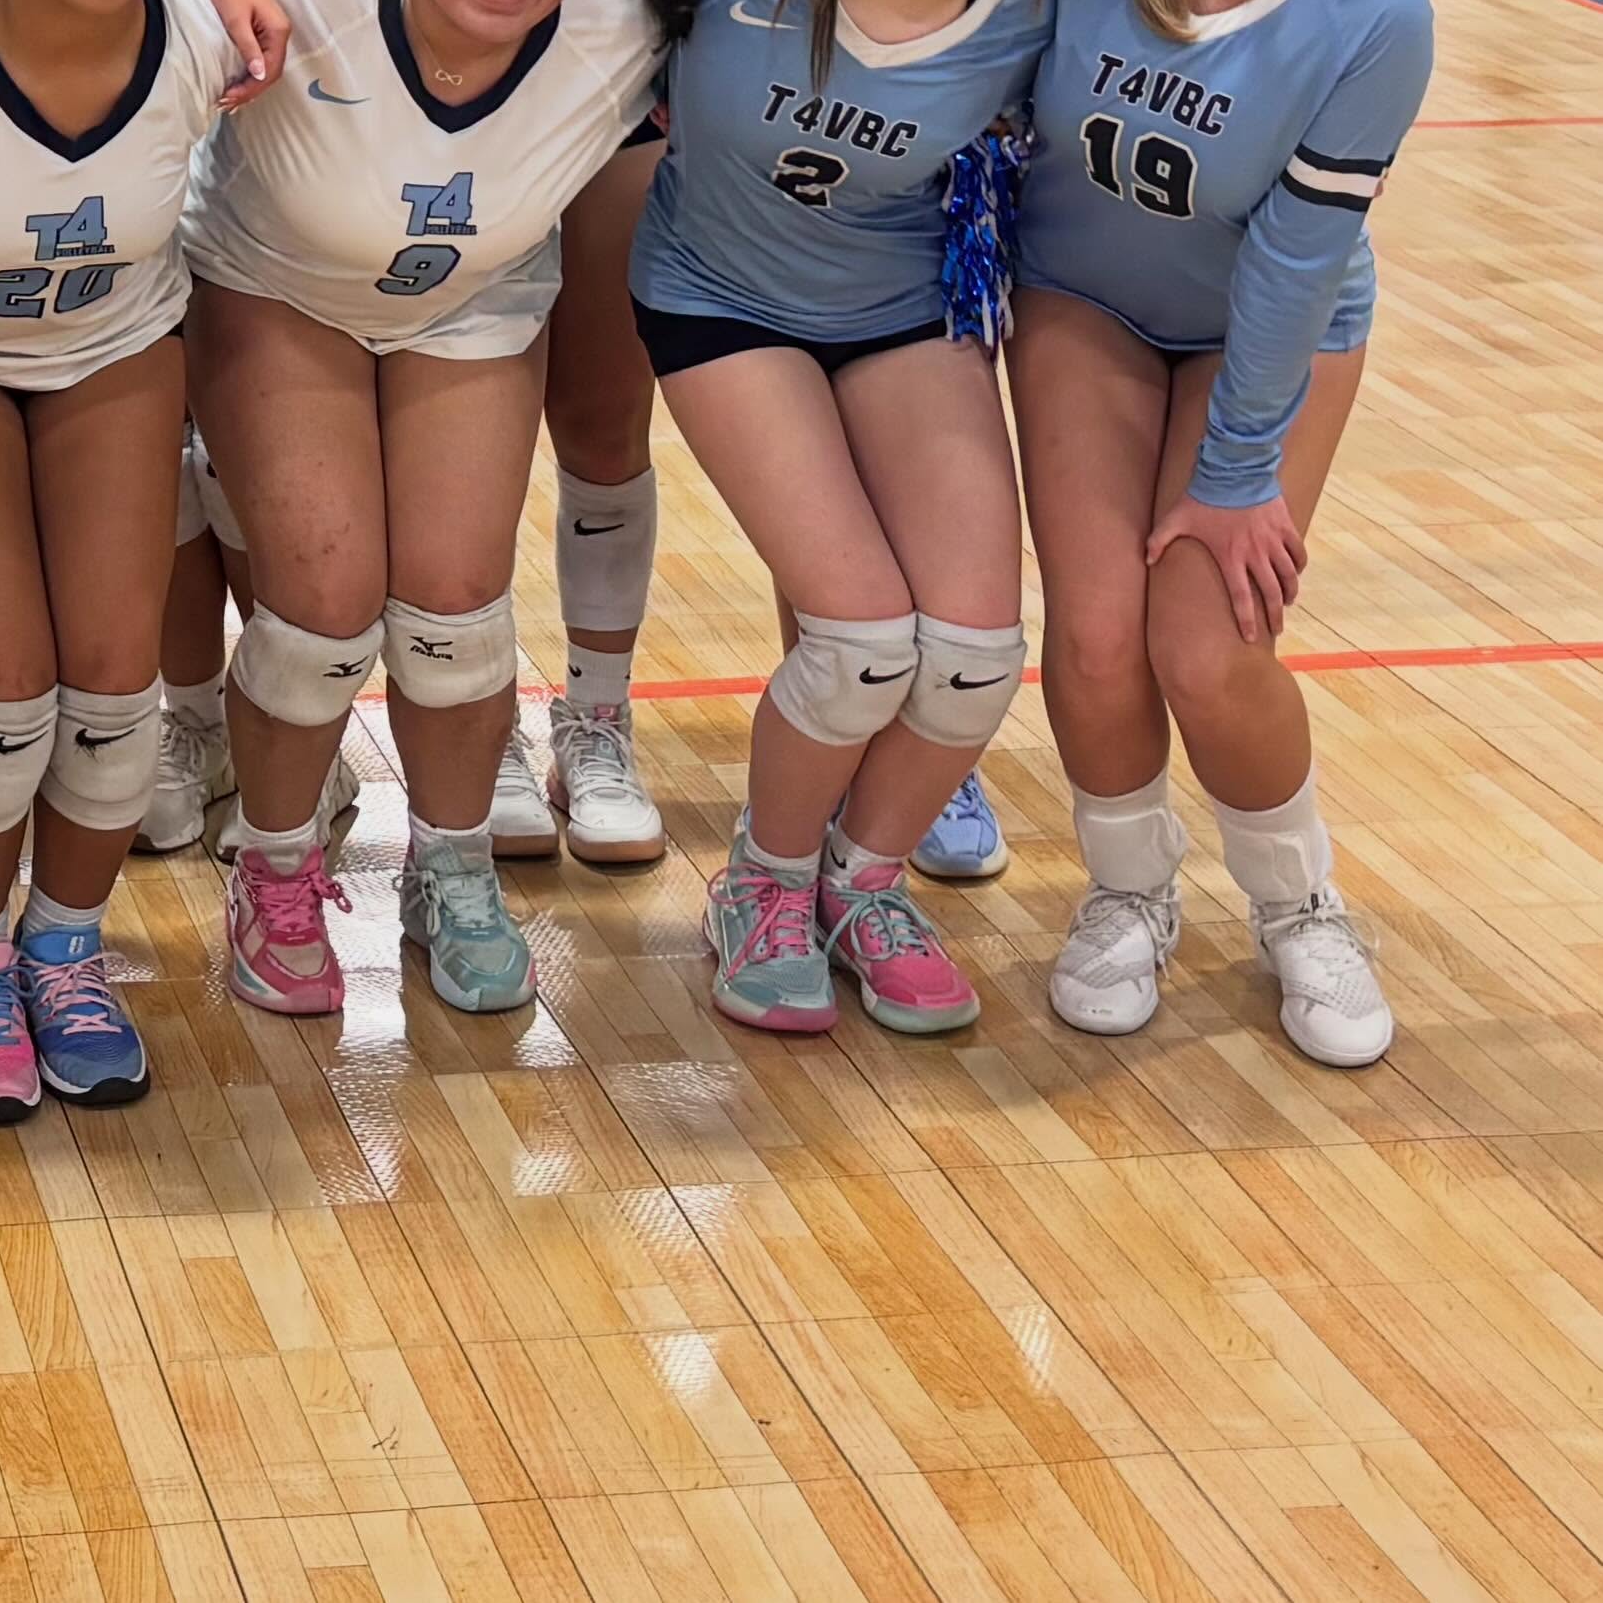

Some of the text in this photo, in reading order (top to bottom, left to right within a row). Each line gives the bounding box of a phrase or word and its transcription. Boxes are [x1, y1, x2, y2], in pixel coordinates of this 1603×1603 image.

[762, 81, 920, 158] T4VBC
[1091, 51, 1234, 137] T4VBC
[772, 146, 850, 209] 2
[1080, 112, 1197, 220] 19
[25, 195, 107, 261] T4
[401, 172, 473, 236] T4
[374, 244, 462, 296] 9
